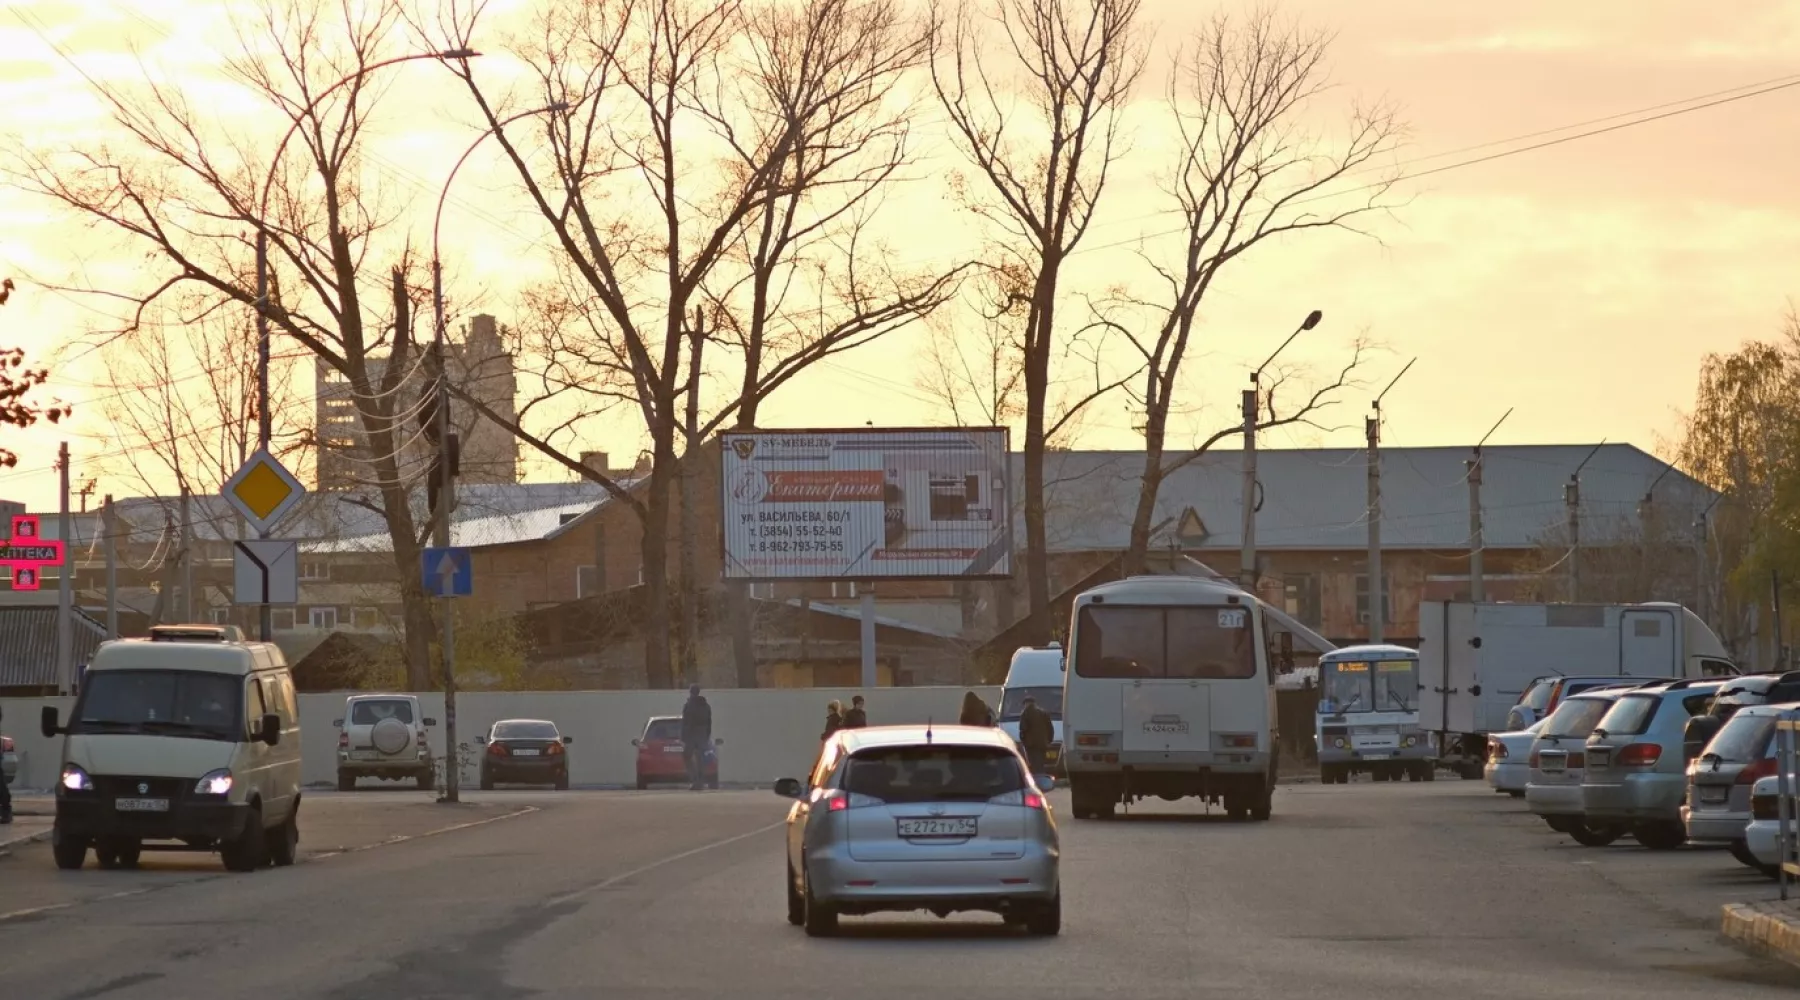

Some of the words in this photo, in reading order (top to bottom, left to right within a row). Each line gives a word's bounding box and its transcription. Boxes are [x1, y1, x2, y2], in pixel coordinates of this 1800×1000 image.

[762, 438, 832, 449] SV-МЕБЕЛЬ
[768, 473, 881, 501] Екатерина
[741, 513, 756, 524] ул.
[827, 510, 851, 523] 60/1
[759, 526, 793, 538] (3854)
[796, 526, 842, 536] 55-52-40
[759, 541, 844, 552] 8-962-793-75-55
